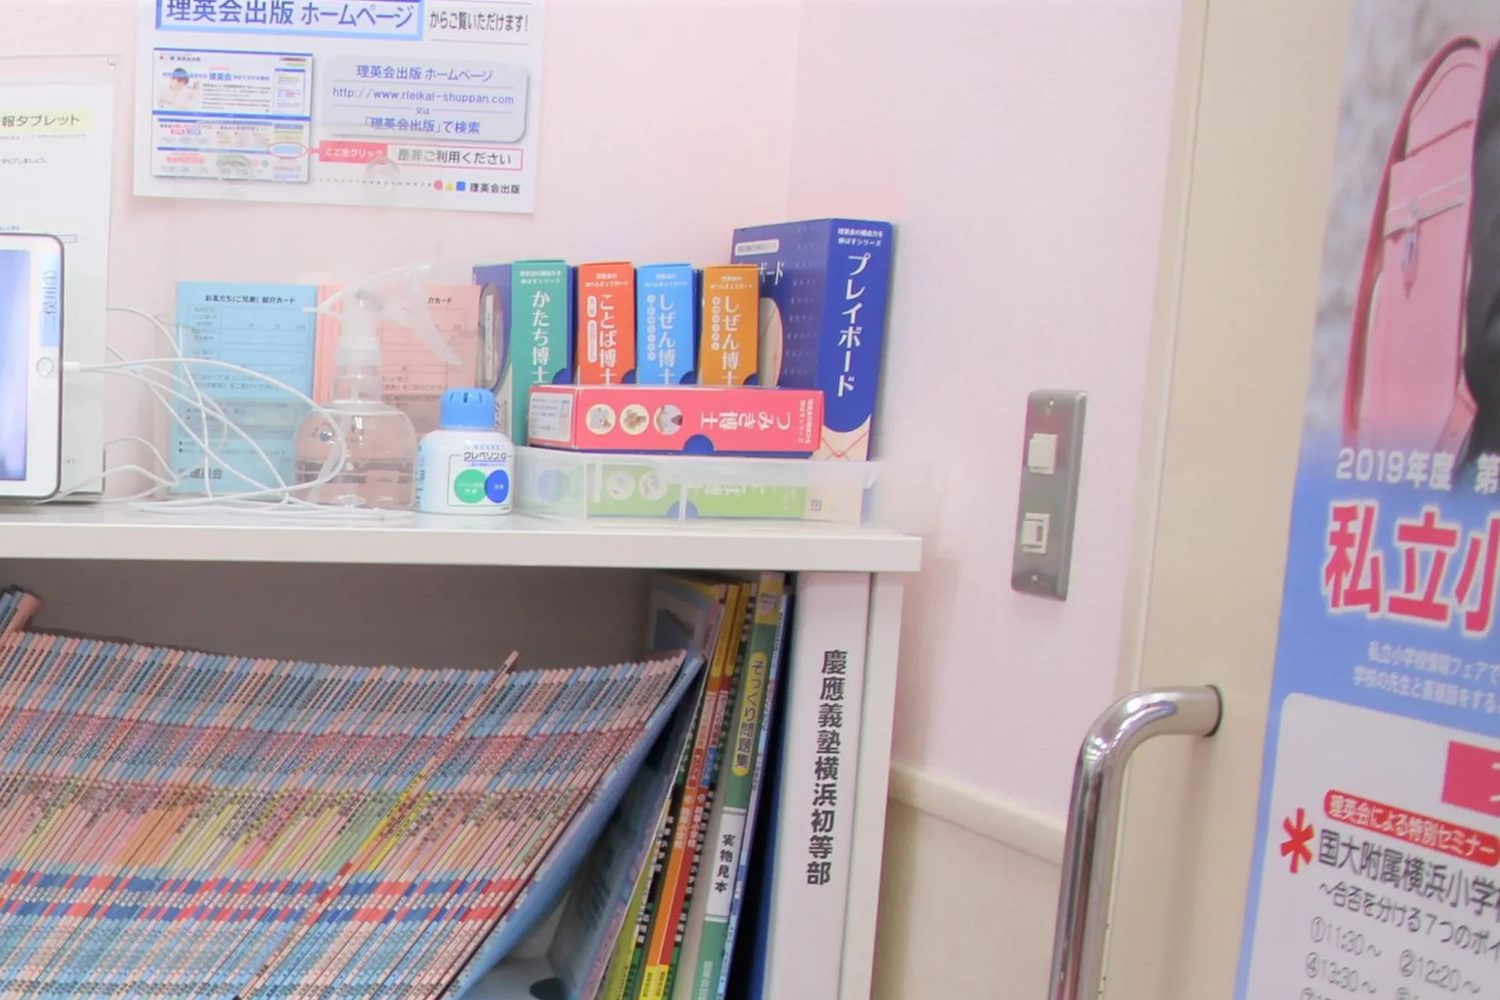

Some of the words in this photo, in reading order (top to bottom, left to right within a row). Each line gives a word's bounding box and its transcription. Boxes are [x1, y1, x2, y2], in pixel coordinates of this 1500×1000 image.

[300, 2, 414, 29] ホームページ
[356, 64, 422, 81] 理英会出版
[425, 67, 493, 82] ホームページ
[364, 116, 481, 136] 「理英会出版」で検索
[469, 182, 521, 195] 理英会出版
[531, 290, 550, 385] かたち博士
[598, 294, 619, 385] ことば博士
[658, 294, 677, 385] しぜん博士
[721, 295, 741, 385] しぜん博士
[836, 252, 872, 399] プレイボード
[700, 409, 792, 432] つみき博士
[1335, 448, 1456, 491] 2019年度
[1322, 500, 1500, 638] 私立小
[732, 657, 767, 771] そっくり問題集
[805, 649, 849, 886] 慶應義塾横浜初等部
[713, 832, 737, 895] 実物見本
[1328, 794, 1496, 859] 理英会による特別セミナー
[1317, 828, 1500, 925] 国大附属横浜小学
